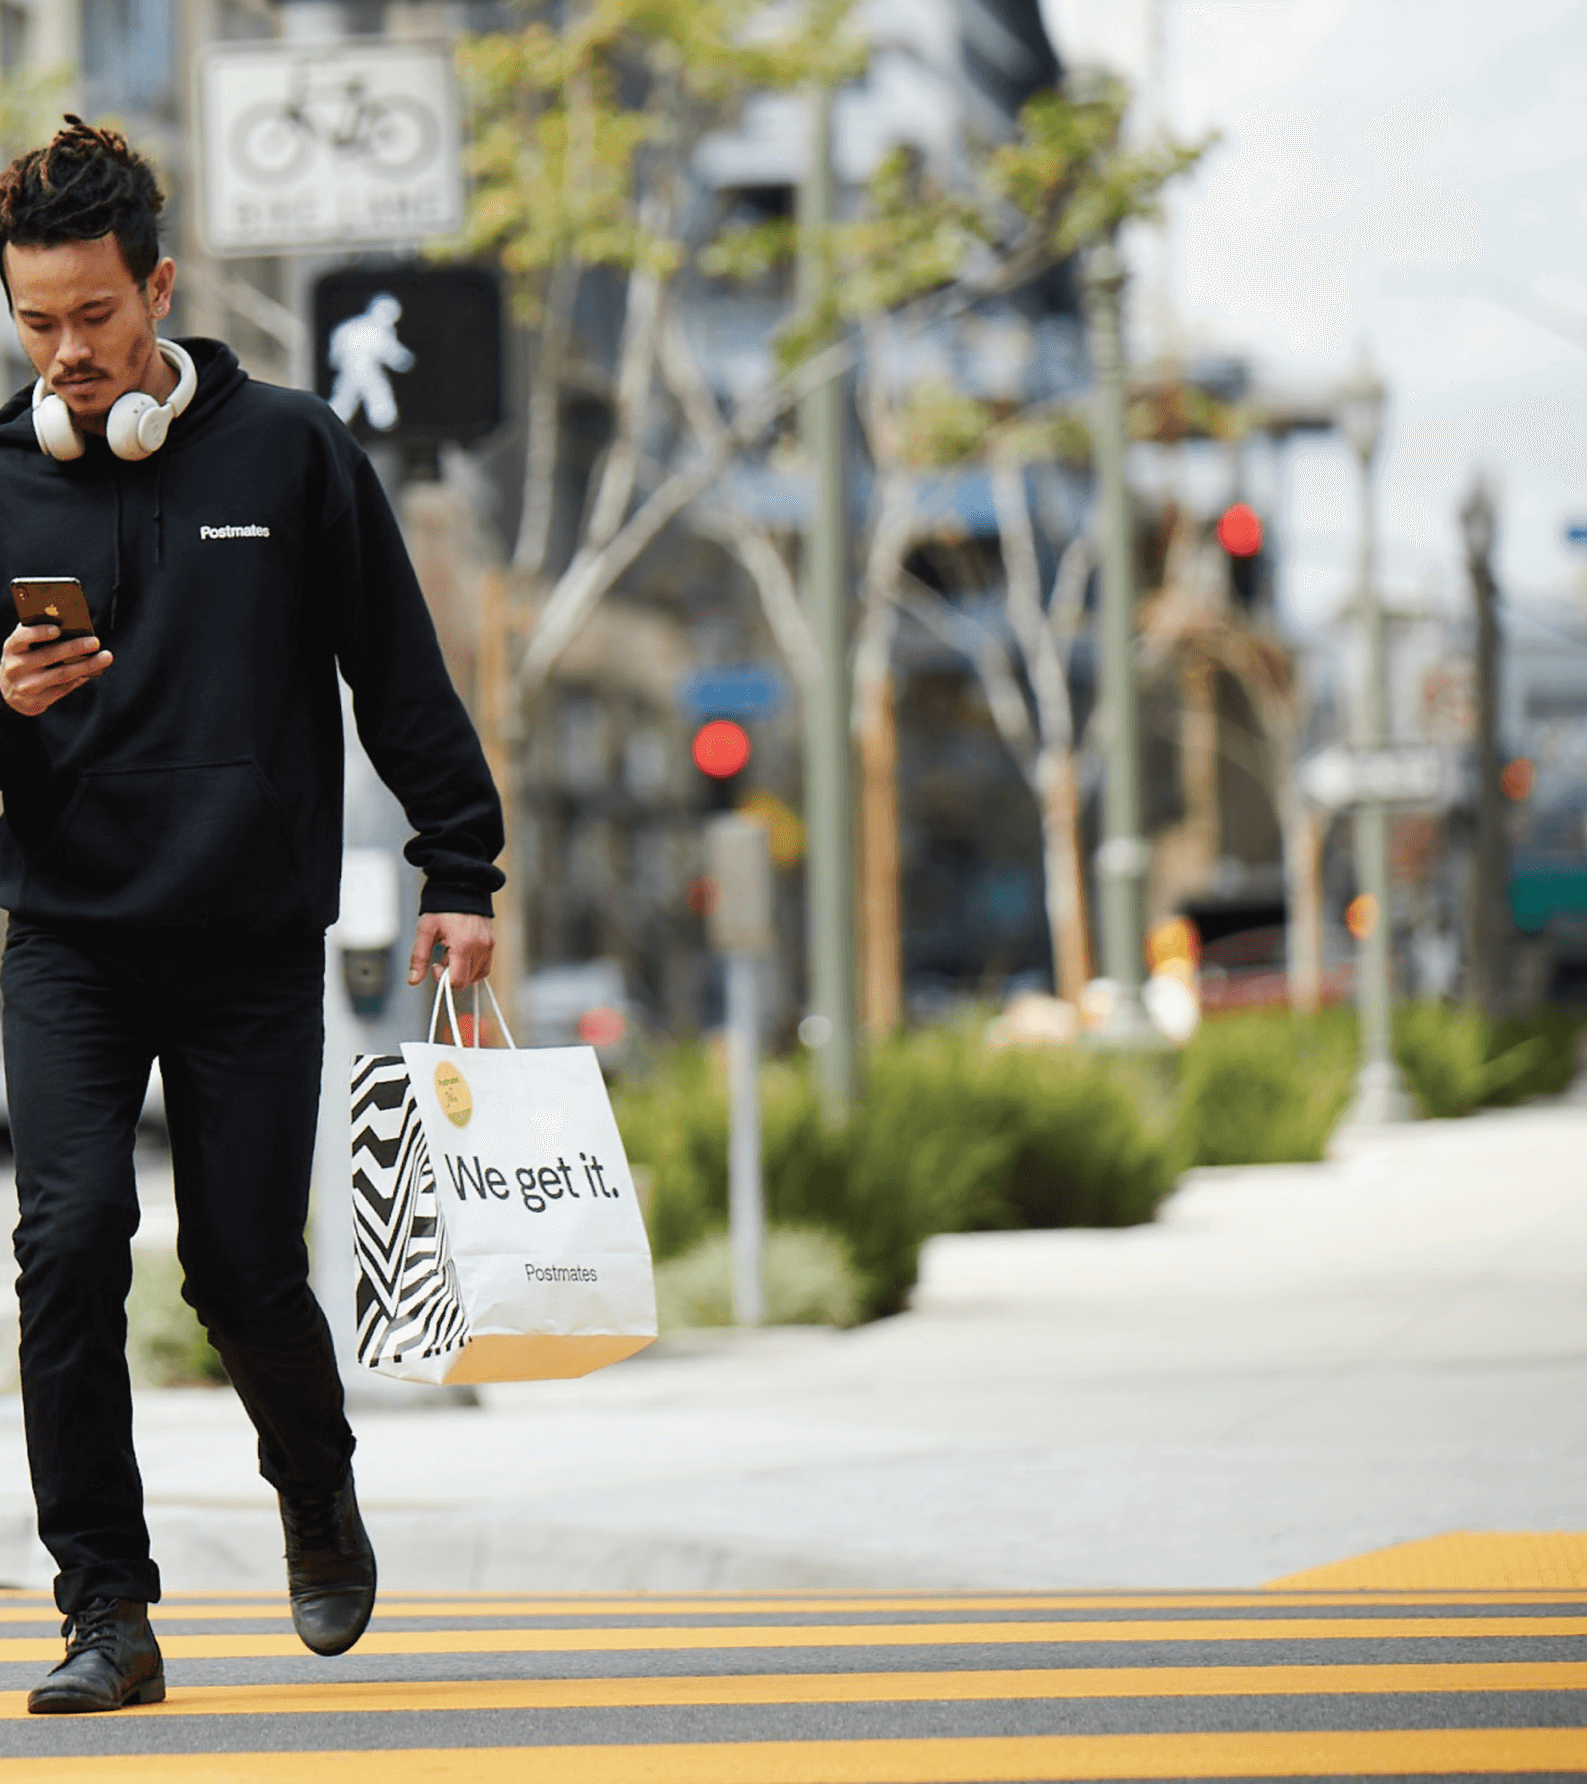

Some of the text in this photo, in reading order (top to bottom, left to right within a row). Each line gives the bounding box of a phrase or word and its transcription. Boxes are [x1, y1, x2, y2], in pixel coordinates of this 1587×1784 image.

[200, 524, 270, 540] Postmates
[444, 1151, 619, 1213] We get it.
[525, 1263, 598, 1282] Postmates
